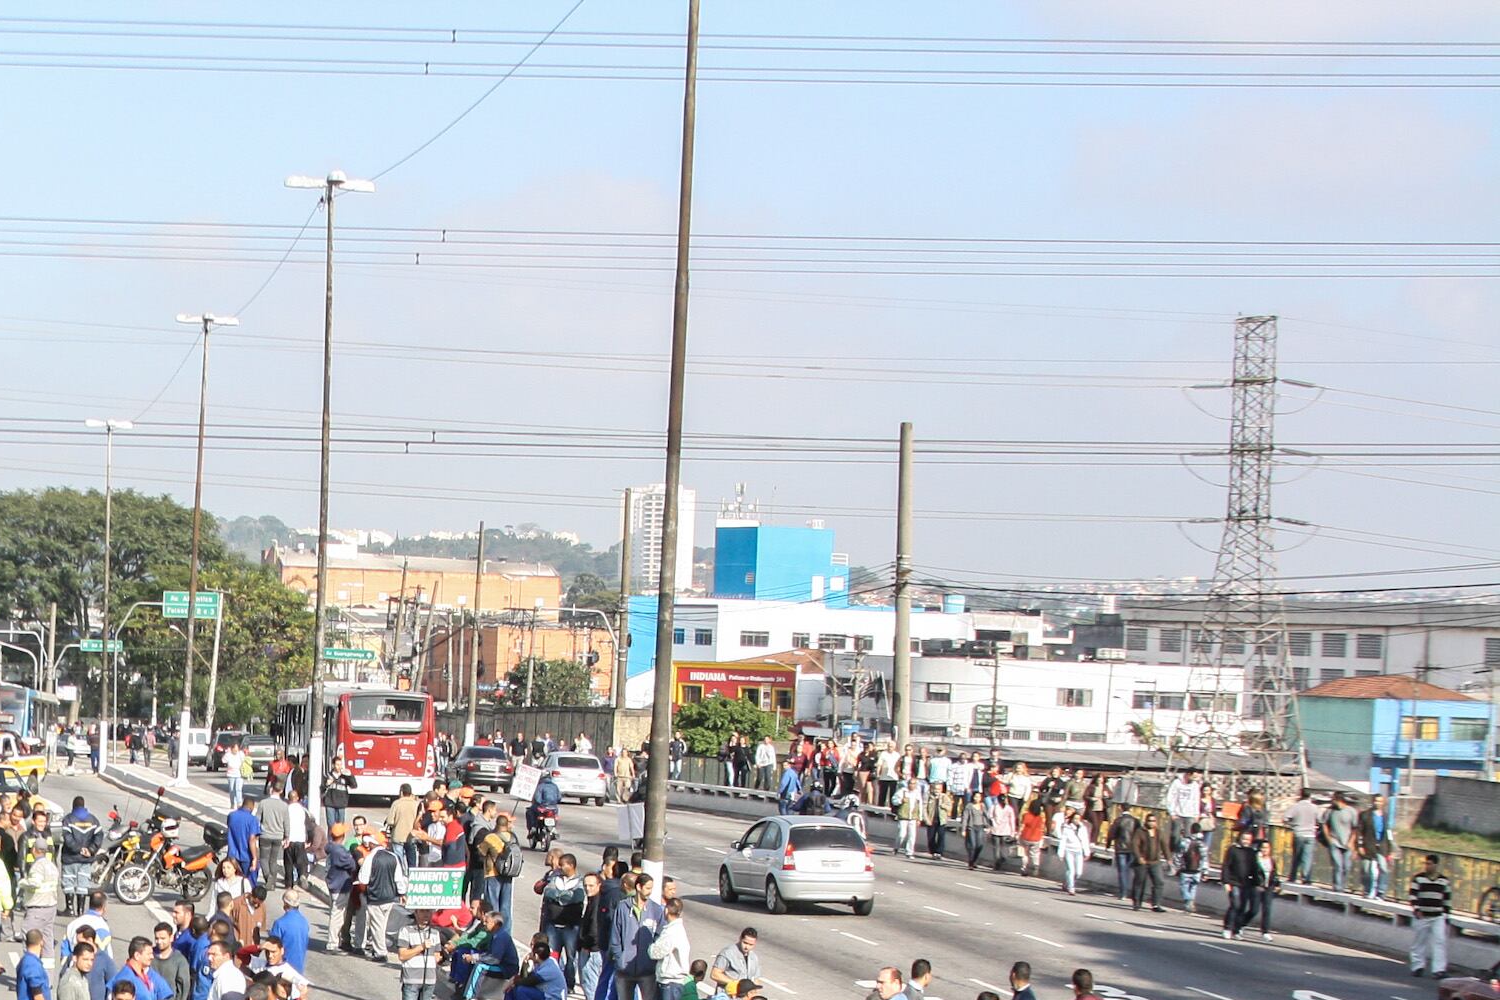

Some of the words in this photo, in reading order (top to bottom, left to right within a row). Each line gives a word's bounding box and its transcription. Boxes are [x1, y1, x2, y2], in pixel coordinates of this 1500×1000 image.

[690, 671, 726, 681] INDIANA
[409, 871, 449, 882] AUMENTO
[408, 883, 430, 894] PARA
[431, 883, 444, 894] OS
[405, 895, 462, 906] APOSENTADOS
